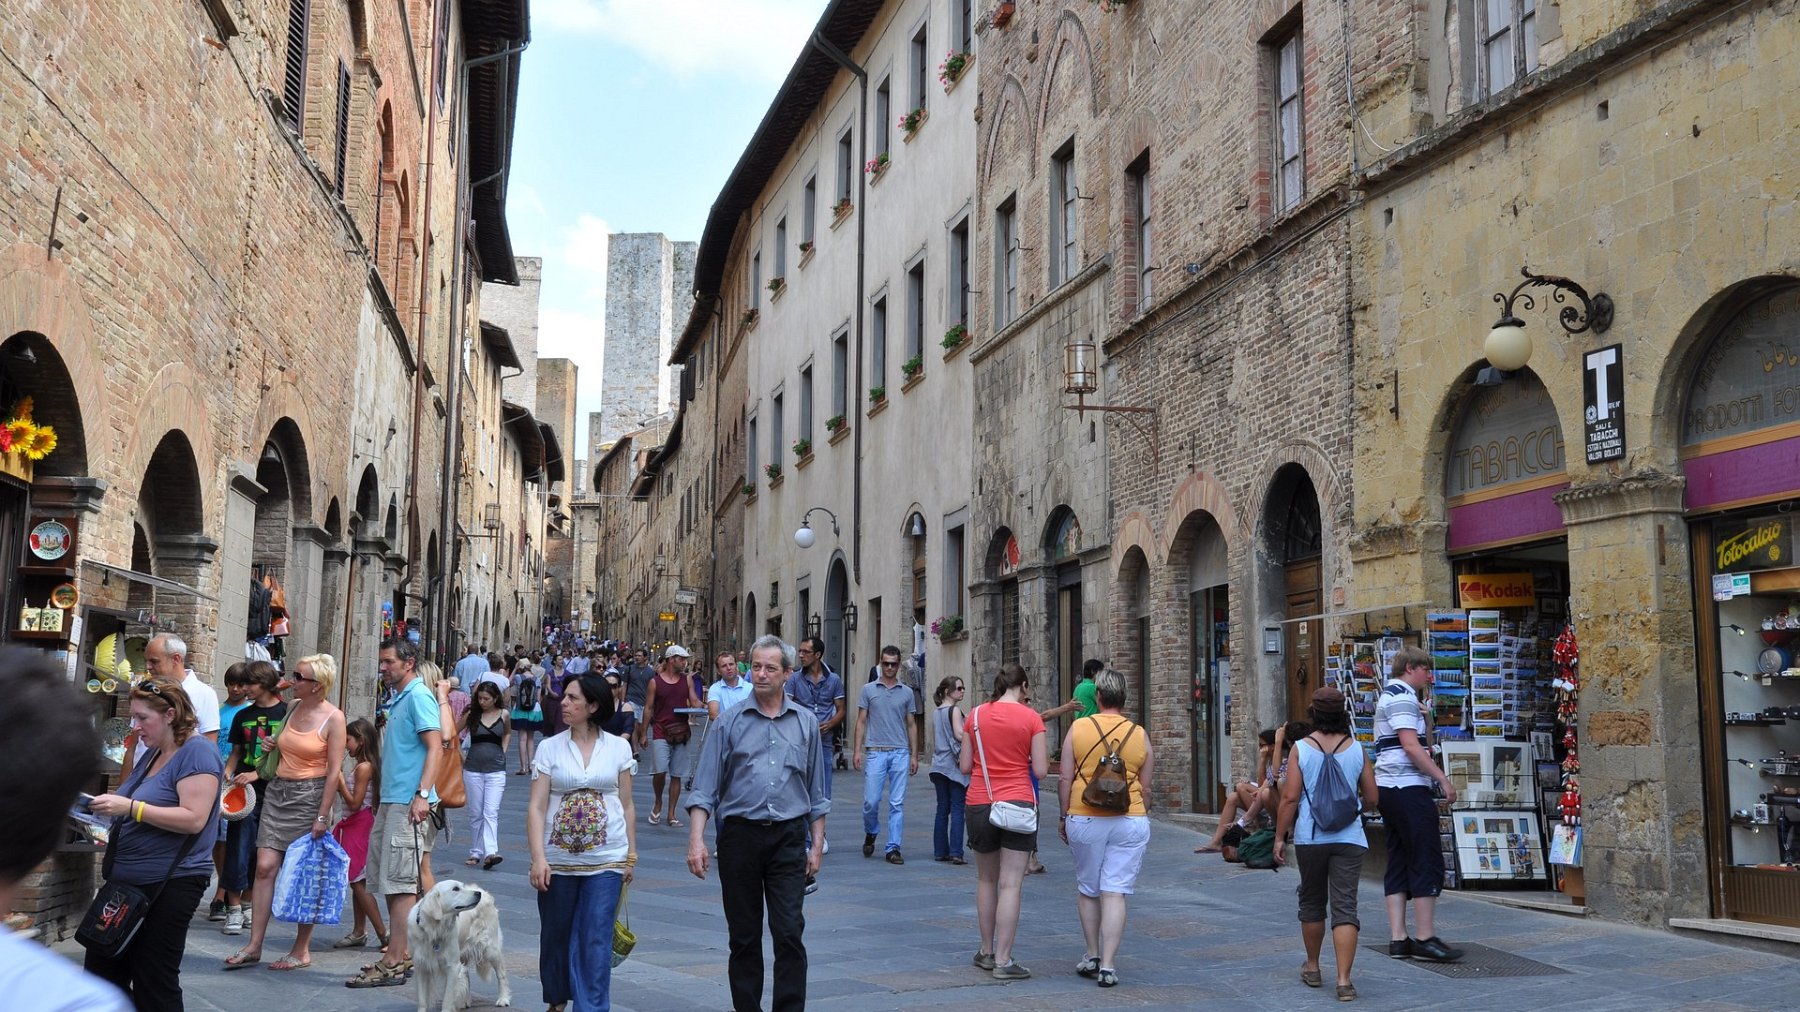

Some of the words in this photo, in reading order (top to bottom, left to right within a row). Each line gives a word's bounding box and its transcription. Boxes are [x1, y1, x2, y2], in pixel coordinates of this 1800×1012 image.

[1587, 348, 1616, 420] T
[1595, 423, 1607, 431] SALI
[1686, 393, 1764, 435] PRODOTTI
[1590, 428, 1619, 442] TABACCHI
[1716, 519, 1782, 569] Totocalcio
[1482, 582, 1533, 598] Kodak
